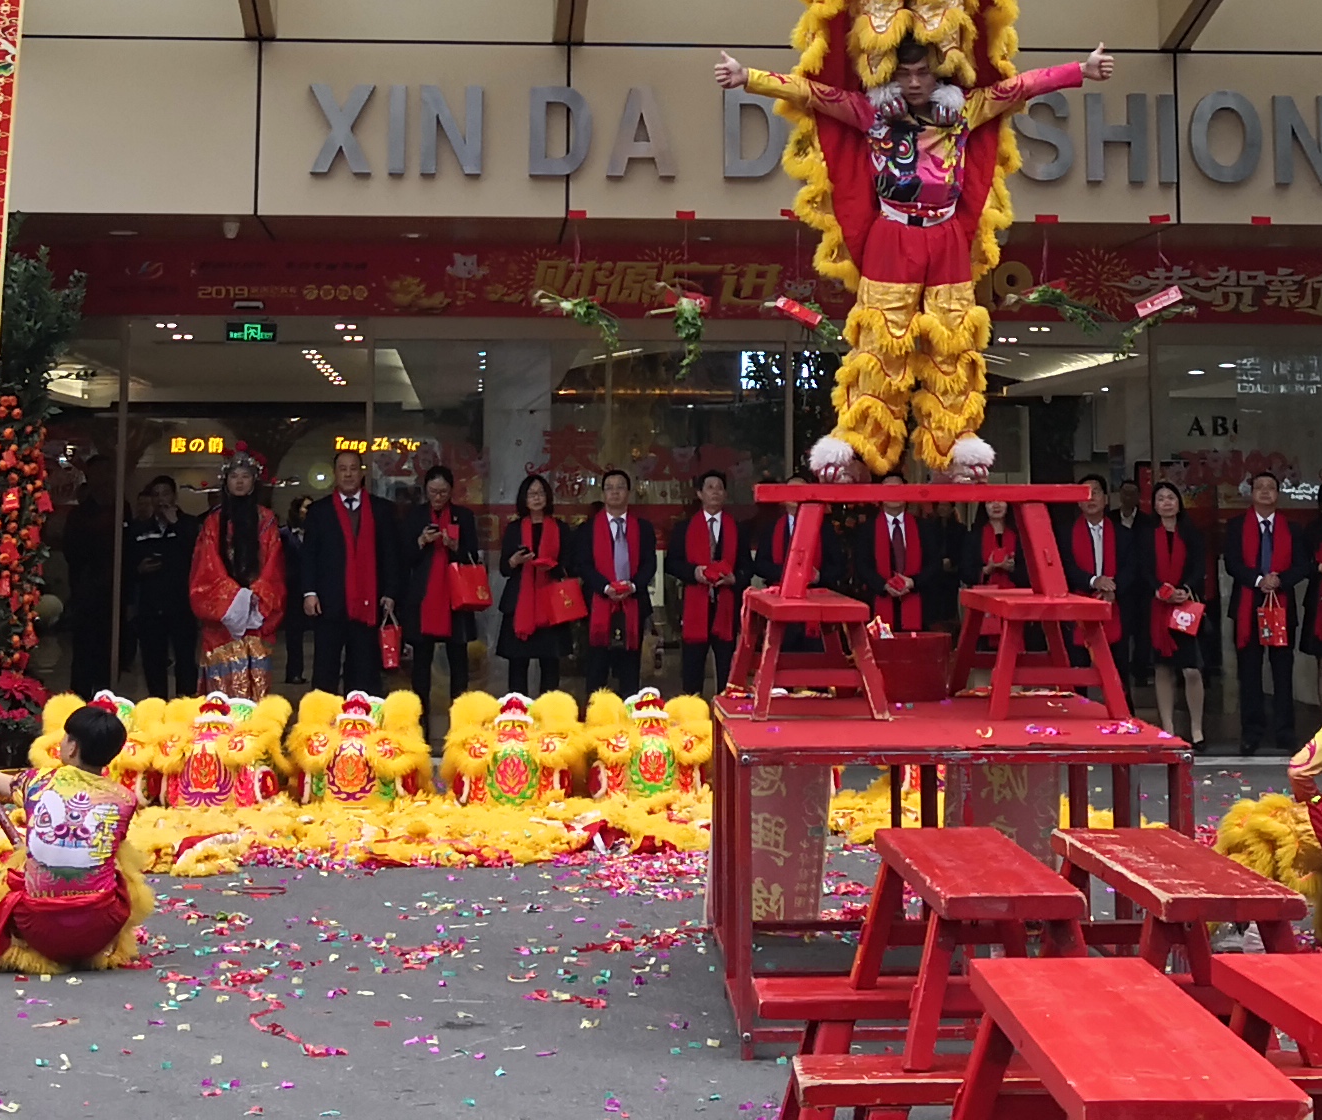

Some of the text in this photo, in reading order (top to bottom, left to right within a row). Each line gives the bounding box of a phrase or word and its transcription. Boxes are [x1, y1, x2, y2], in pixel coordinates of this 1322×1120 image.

[309, 83, 483, 176] XIN
[529, 86, 676, 178] DA
[197, 286, 248, 299] 2019
[1187, 416, 1238, 437] AB
[335, 437, 367, 454] Tang
